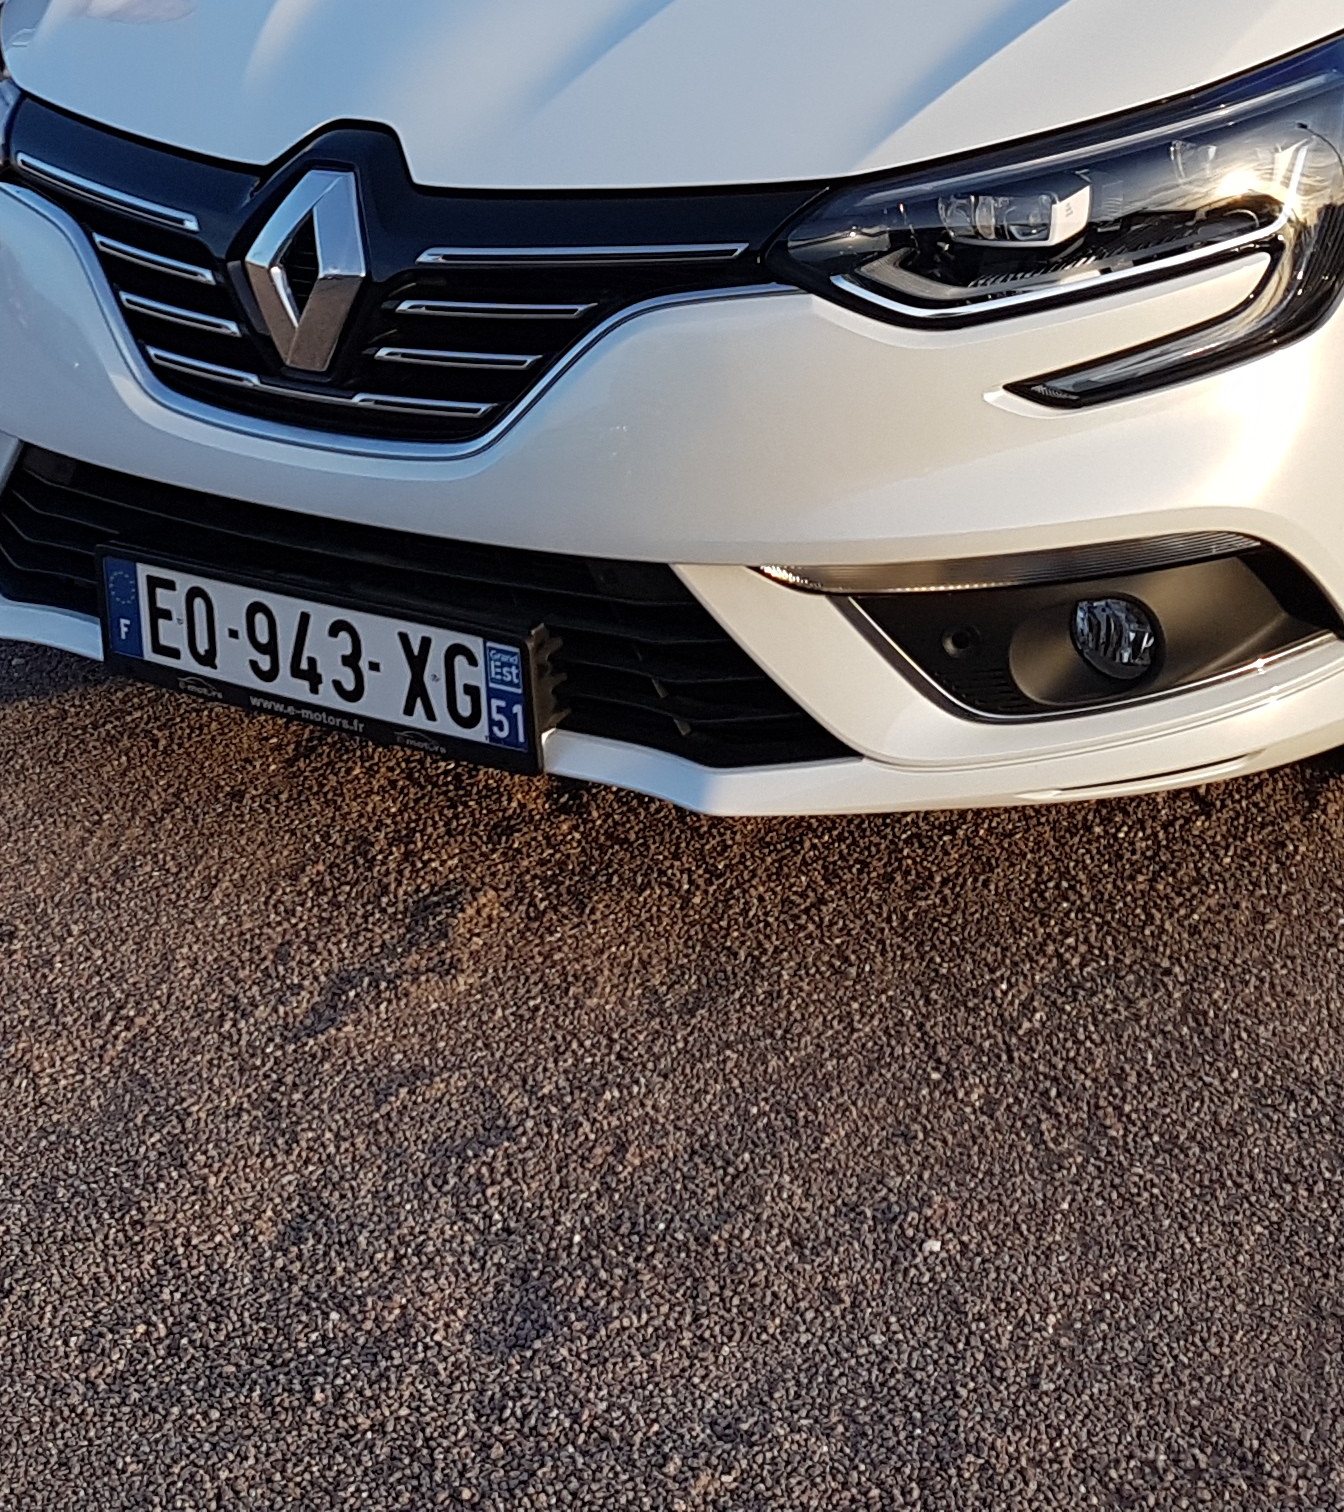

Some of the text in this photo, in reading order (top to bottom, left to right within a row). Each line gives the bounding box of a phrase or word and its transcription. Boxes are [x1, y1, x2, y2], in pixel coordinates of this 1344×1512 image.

[119, 618, 131, 640] F
[489, 649, 519, 666] Grand
[490, 660, 520, 684] Est
[249, 695, 365, 733] www.e-motors.fr
[490, 698, 525, 743] 51
